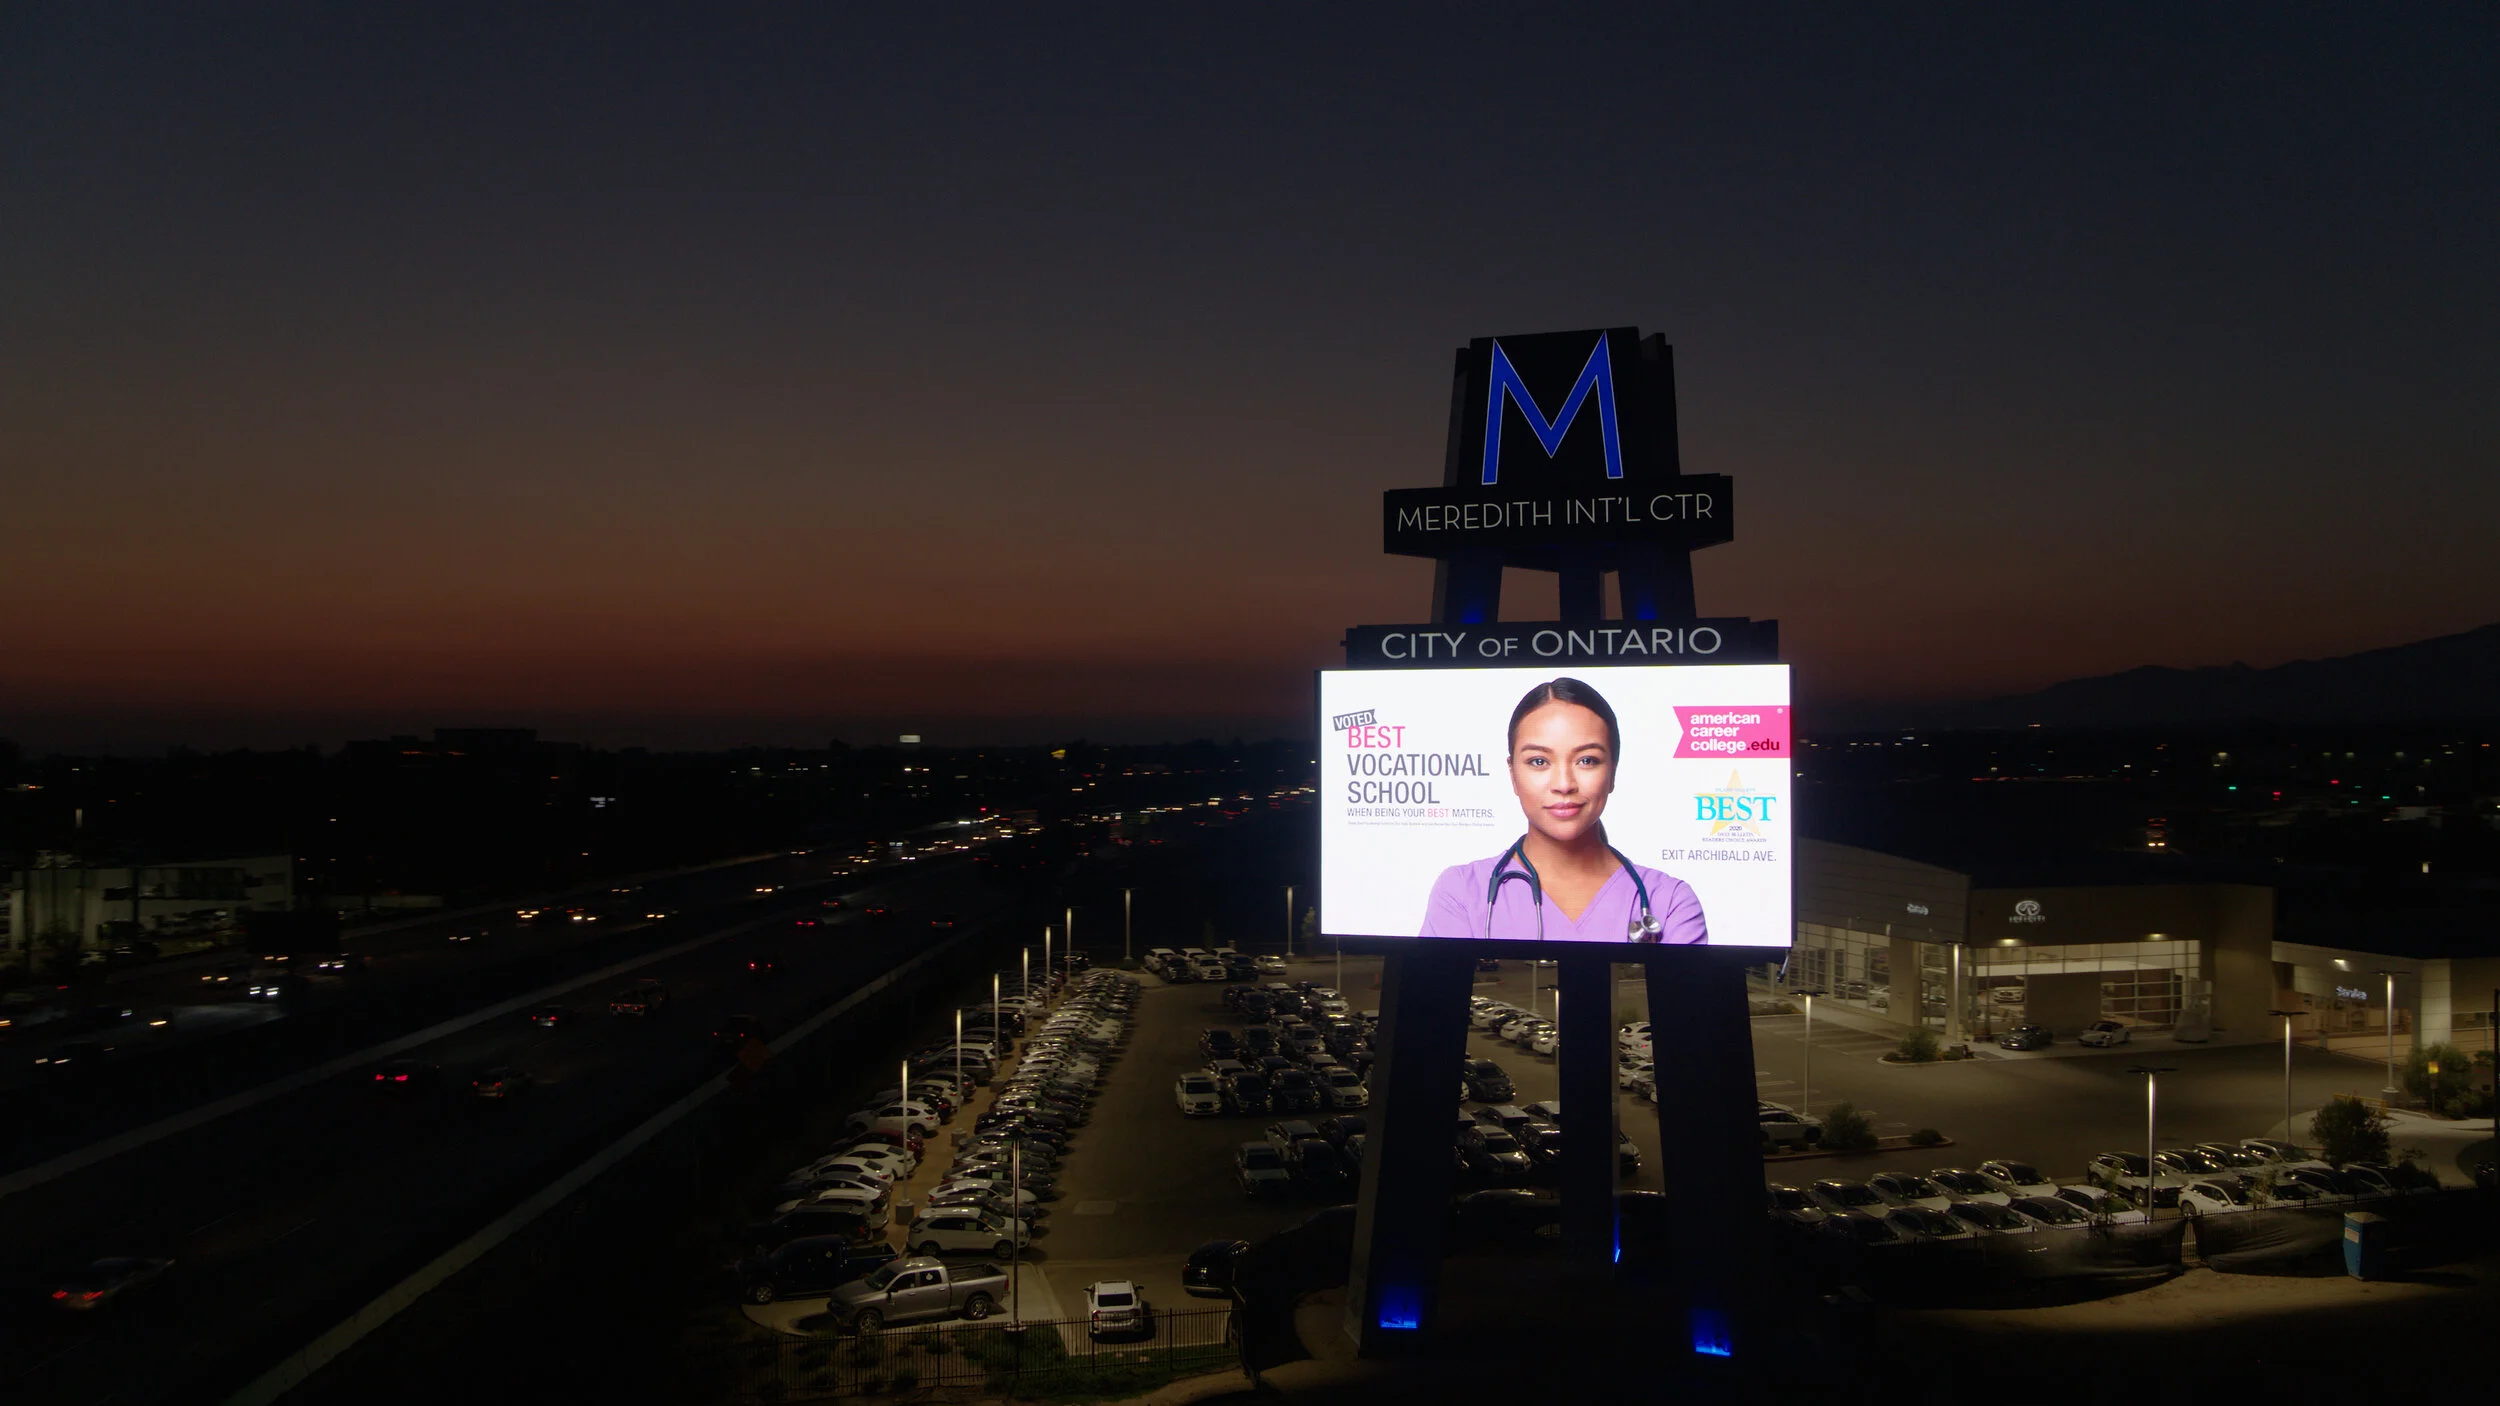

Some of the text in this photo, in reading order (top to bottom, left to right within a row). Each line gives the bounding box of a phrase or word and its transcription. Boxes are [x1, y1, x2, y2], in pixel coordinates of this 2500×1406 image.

[1397, 493, 1713, 533] MEREDITH INT'L CTR
[1381, 631, 1467, 660] CITY
[1531, 626, 1723, 657] ONTARIO
[1334, 711, 1373, 730] VOTED
[1690, 712, 1761, 725] american
[1348, 725, 1406, 749] BEST
[1690, 726, 1740, 737] career
[1690, 738, 1780, 754] college.edu
[1347, 753, 1490, 776] VOCATIONAL
[1347, 781, 1440, 804] SCHOOL
[1347, 807, 1495, 819] WHEN BEING YOUR BEST MATTERS.
[1693, 795, 1777, 821] BEST
[1662, 849, 1777, 862] EXIT ARCHIBALD AVE.
